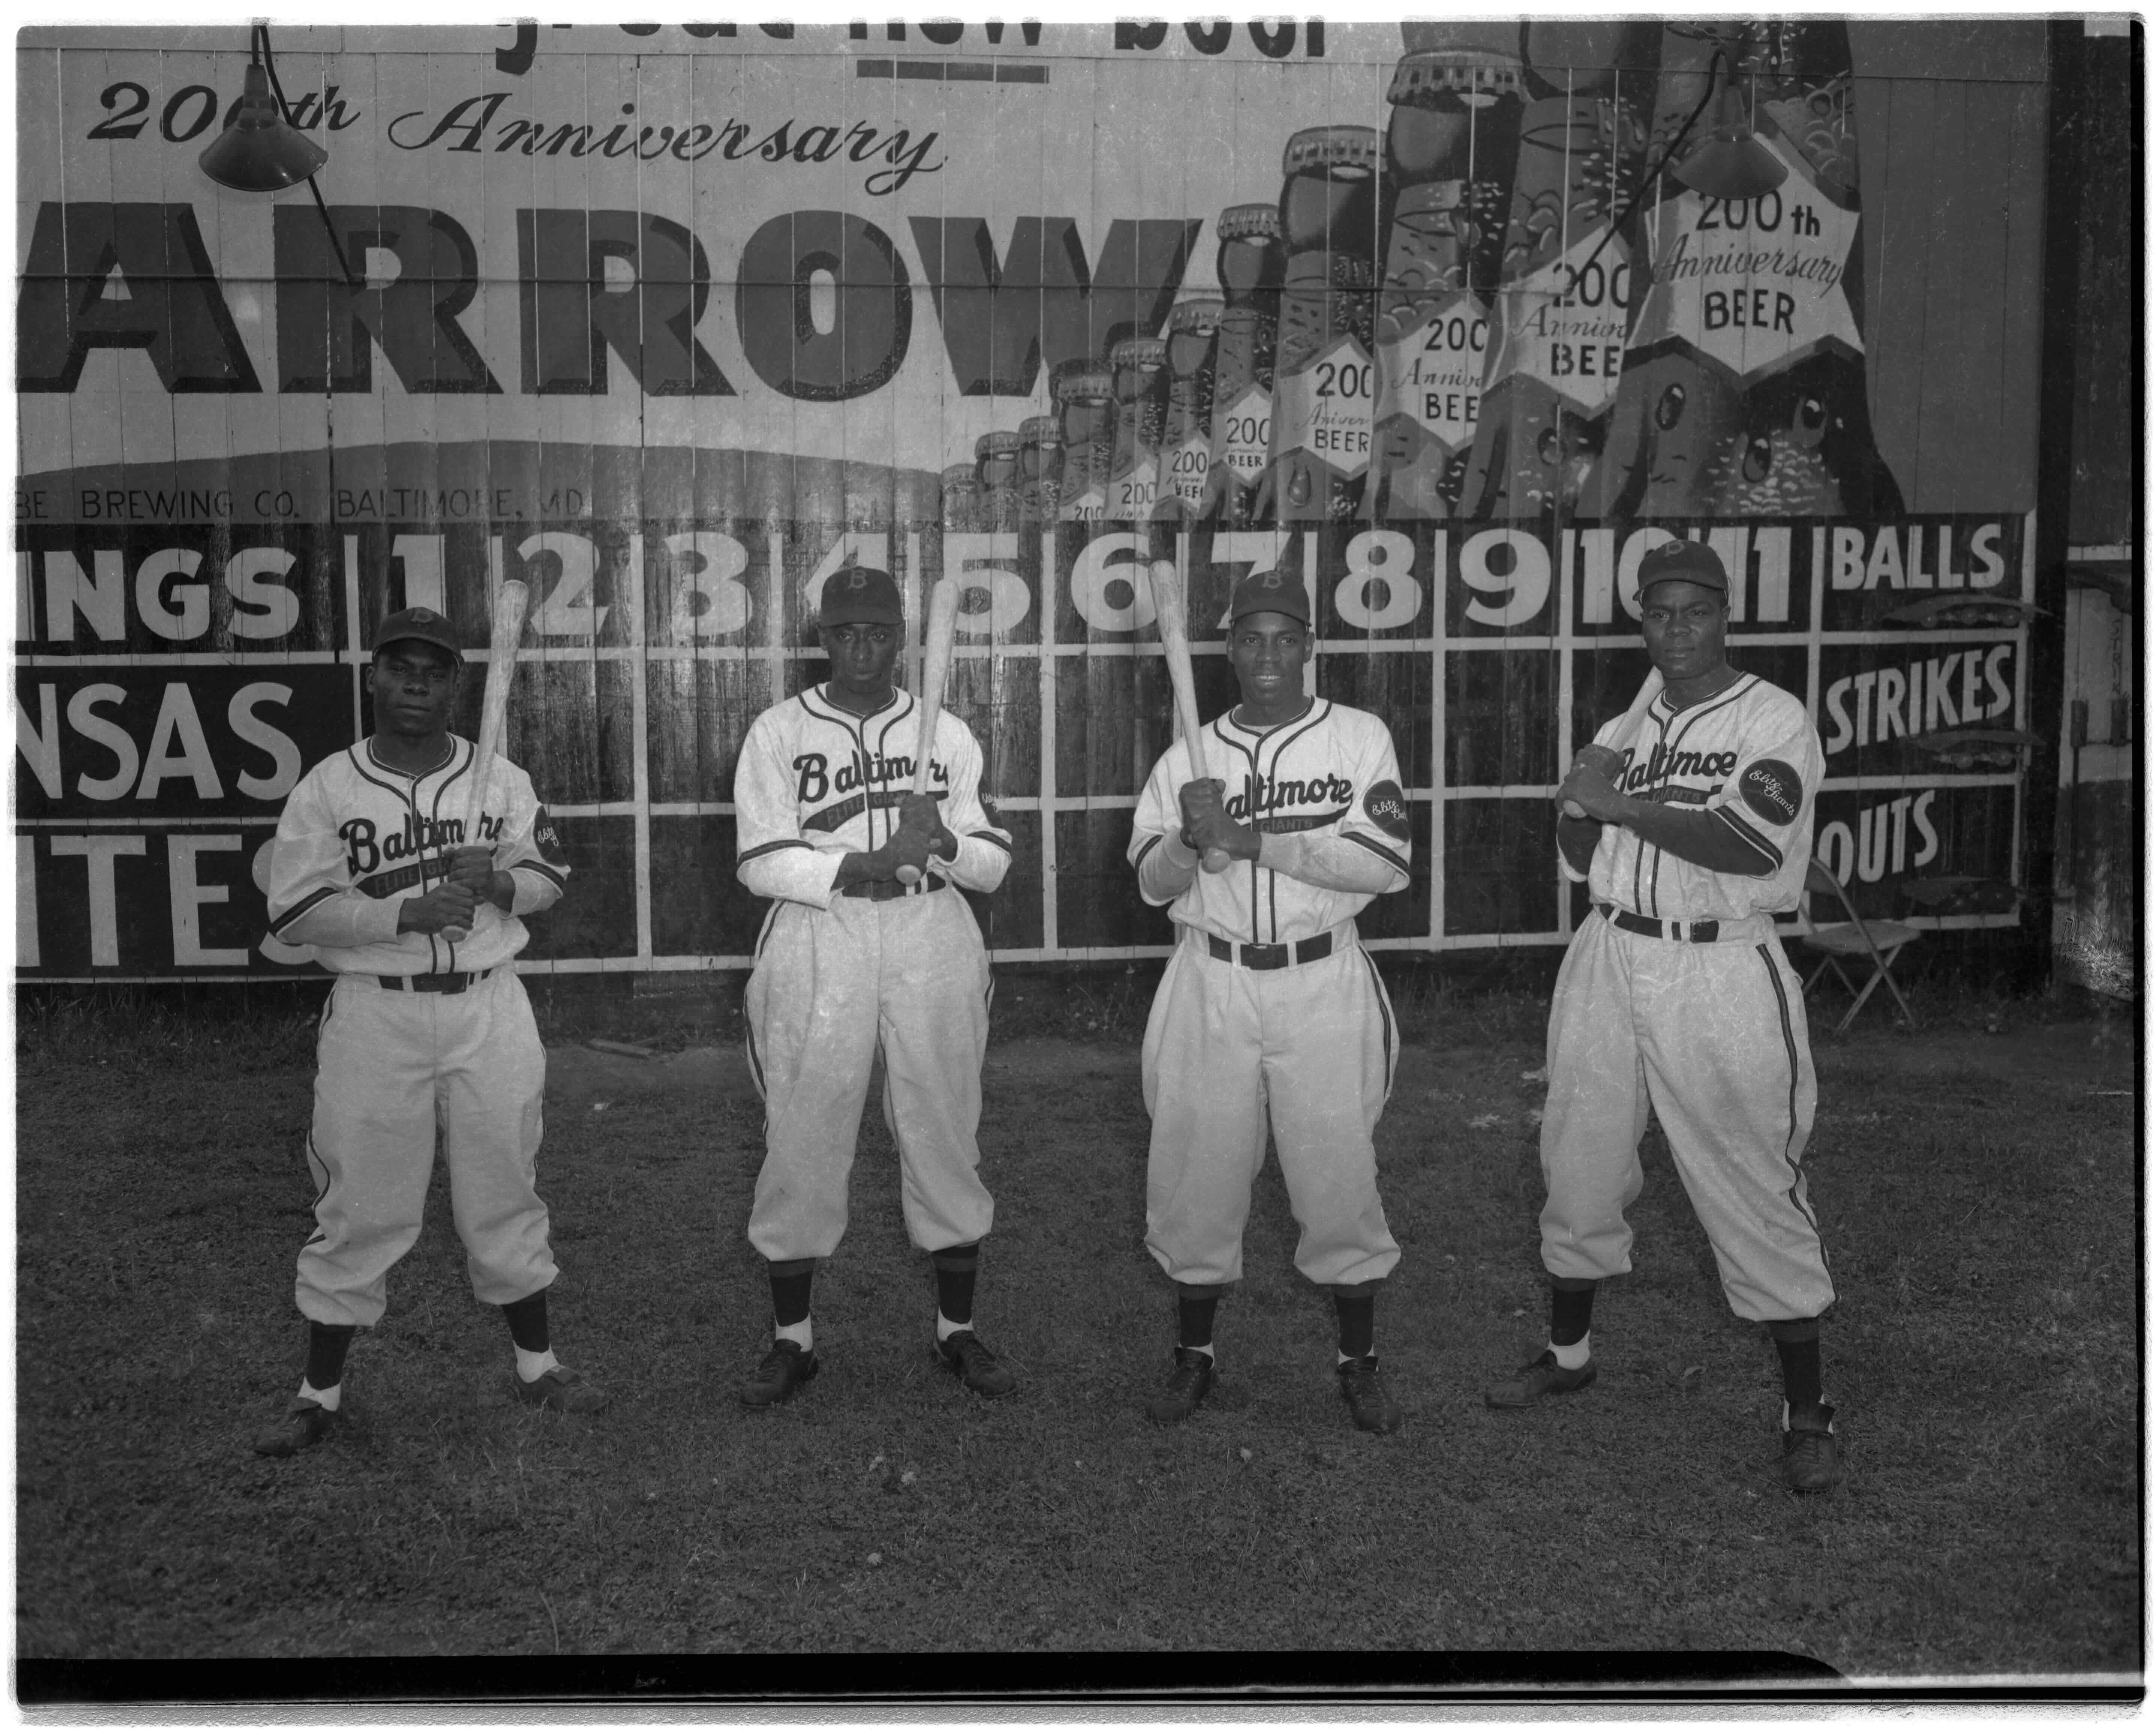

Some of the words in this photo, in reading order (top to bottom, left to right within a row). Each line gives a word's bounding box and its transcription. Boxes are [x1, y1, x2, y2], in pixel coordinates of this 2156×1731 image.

[87, 81, 361, 142] 20th
[388, 93, 948, 196] Anniversary
[1652, 233, 1843, 298] Anniversary
[16, 202, 1203, 402] ARROW
[1705, 289, 1795, 334] BEER
[1172, 450, 1207, 473] 200
[1228, 454, 1262, 467] BEER
[1315, 429, 1369, 452] BEER
[16, 490, 48, 518] BE
[81, 490, 234, 518] BREWING
[254, 490, 300, 517] CO.
[847, 568, 868, 589] B
[1262, 571, 1283, 589] B
[1832, 524, 2005, 590] BALLS
[16, 547, 300, 641] INGS
[391, 534, 447, 618] 1
[517, 531, 609, 636] 2
[664, 531, 753, 636] 3
[942, 532, 1031, 634] 5
[1070, 532, 1158, 632] 6
[1210, 532, 1291, 629] 7
[1335, 530, 1422, 630] 8
[1459, 528, 1551, 626] 9
[1826, 644, 2012, 755] STRIKES
[16, 682, 301, 801] NSAS
[793, 749, 949, 803] Baltimr
[1222, 773, 1353, 819] altimore
[1749, 770, 1780, 790] Elite
[339, 809, 504, 876] Baltimre
[1260, 818, 1313, 832] GIANTS
[1818, 790, 1939, 888] OUTS
